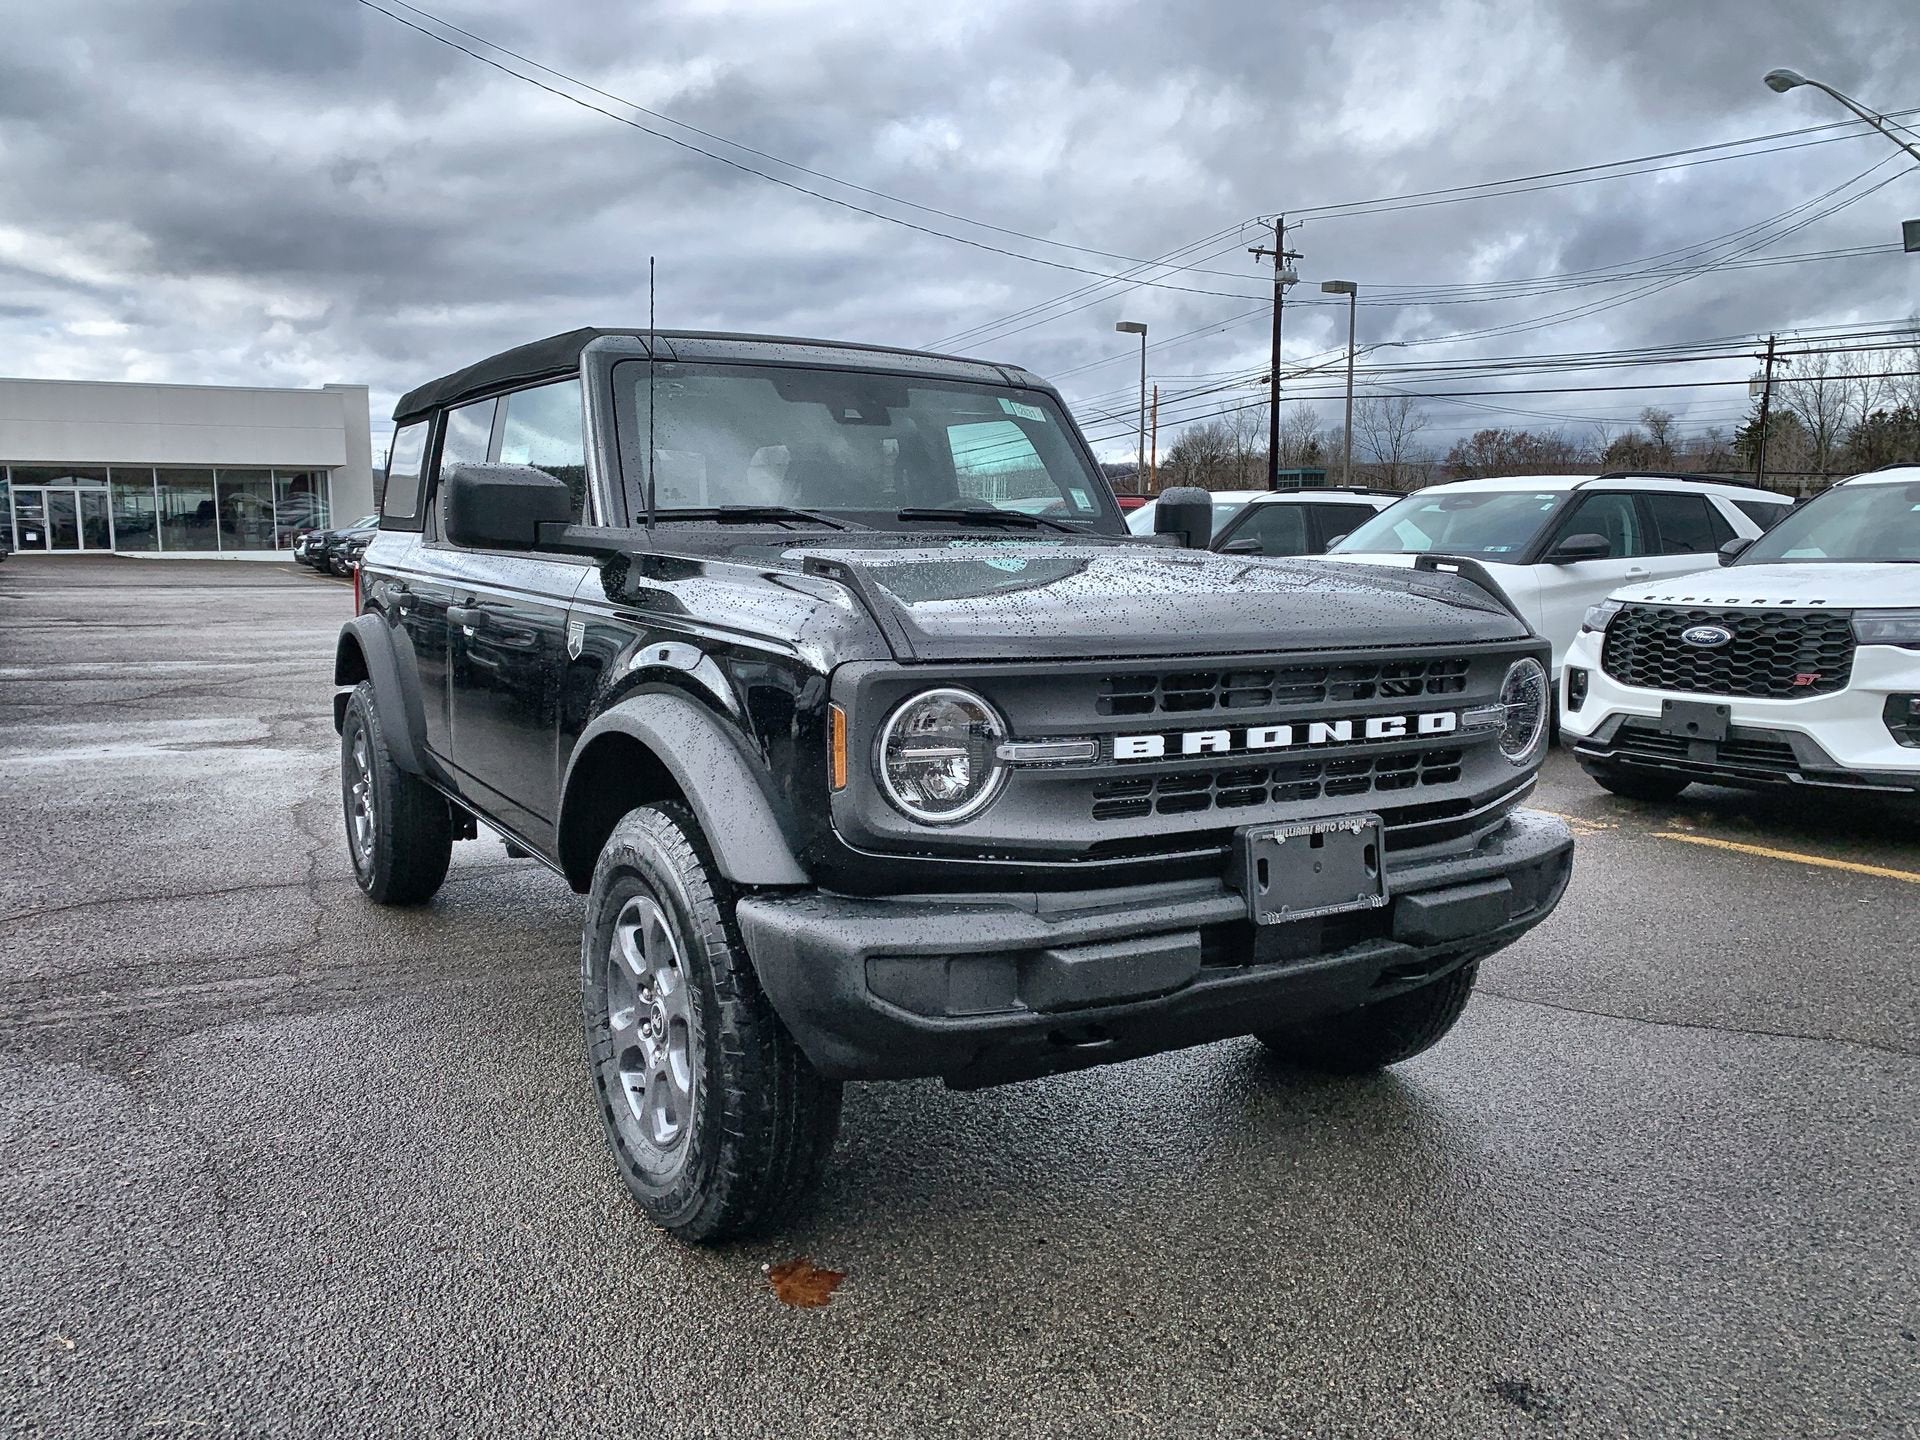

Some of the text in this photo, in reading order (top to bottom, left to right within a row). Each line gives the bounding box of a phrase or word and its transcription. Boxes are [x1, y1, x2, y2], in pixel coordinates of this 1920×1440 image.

[1643, 595, 1827, 605] EXPLORER
[1793, 673, 1821, 686] ST
[1113, 711, 1457, 760] BRONCO
[1315, 821, 1336, 834] AUTO
[1338, 818, 1367, 832] GROUP
